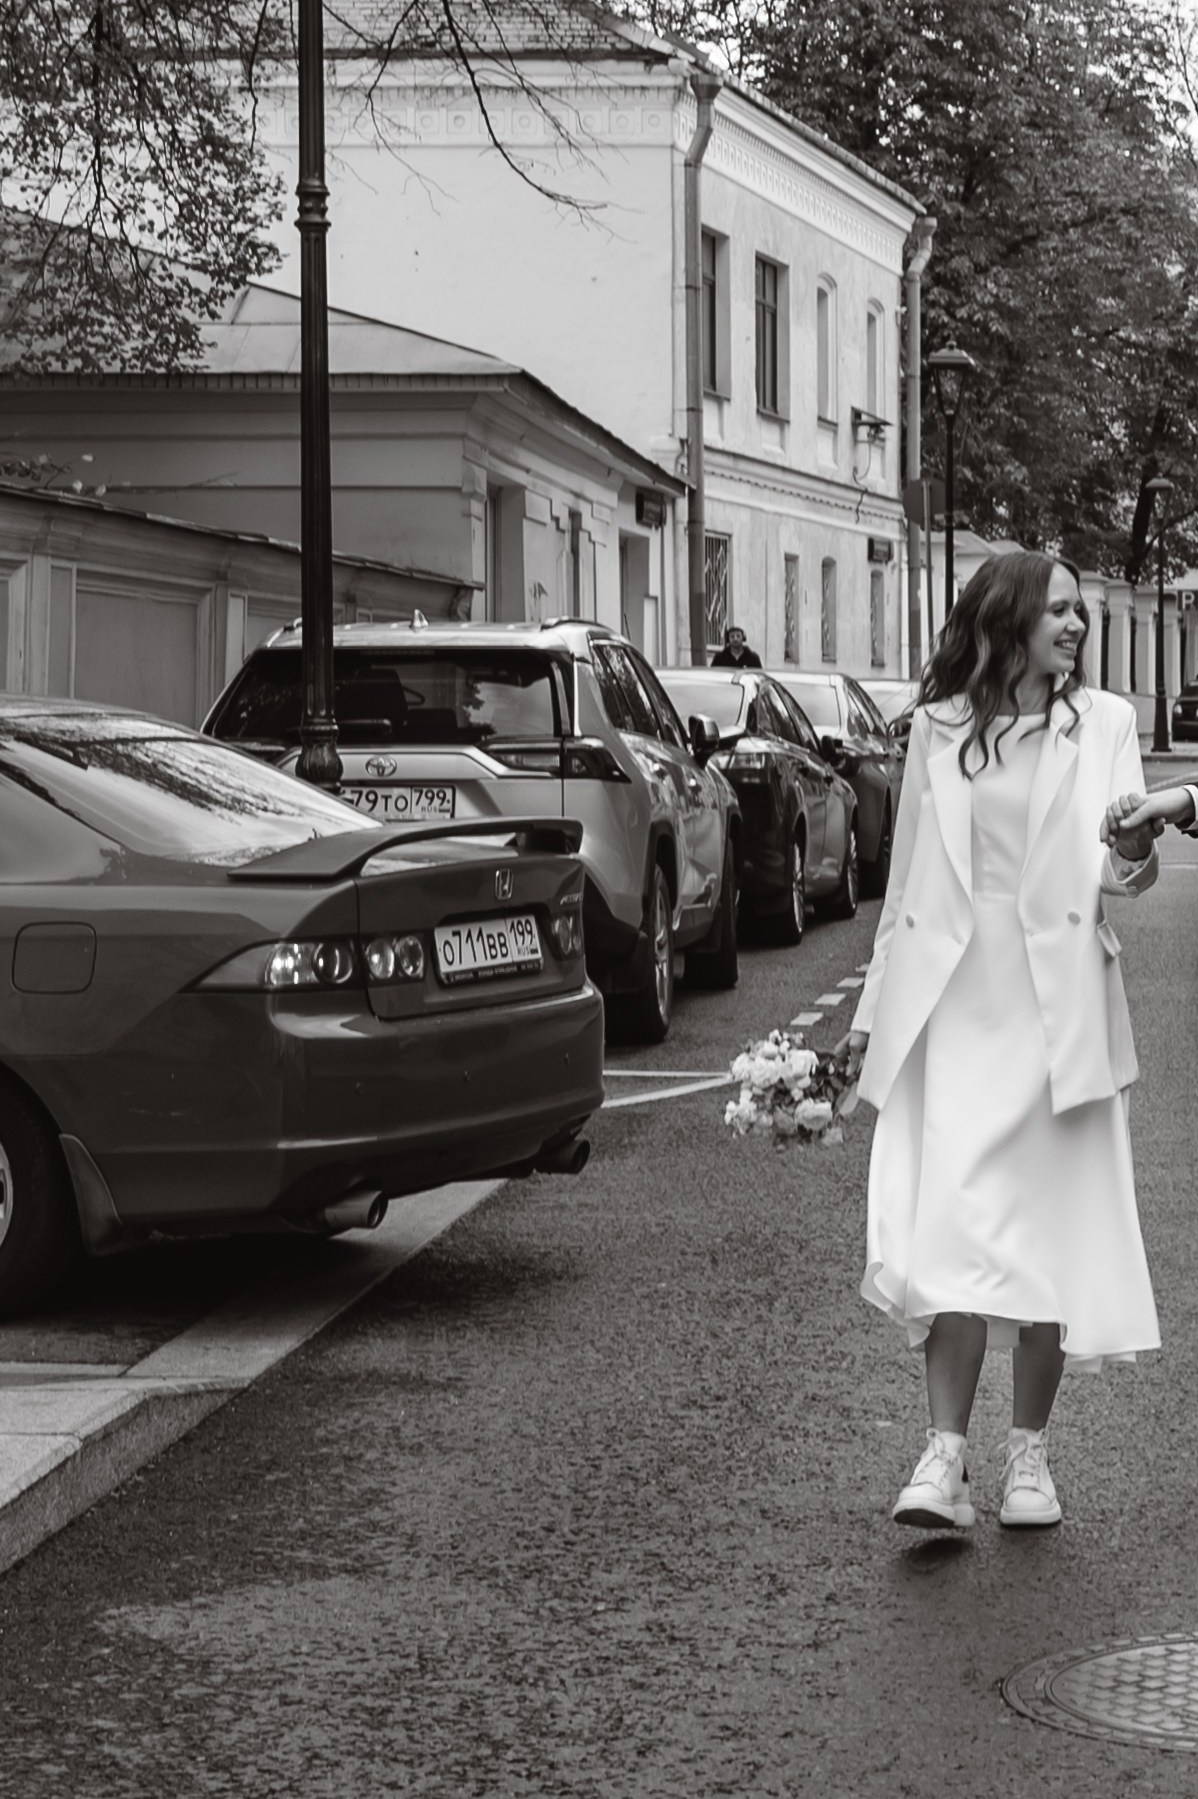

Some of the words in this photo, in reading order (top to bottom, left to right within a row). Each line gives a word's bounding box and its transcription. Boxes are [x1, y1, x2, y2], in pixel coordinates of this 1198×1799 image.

[1181, 591, 1195, 610] P
[413, 788, 447, 807] 799
[509, 918, 533, 946] 199
